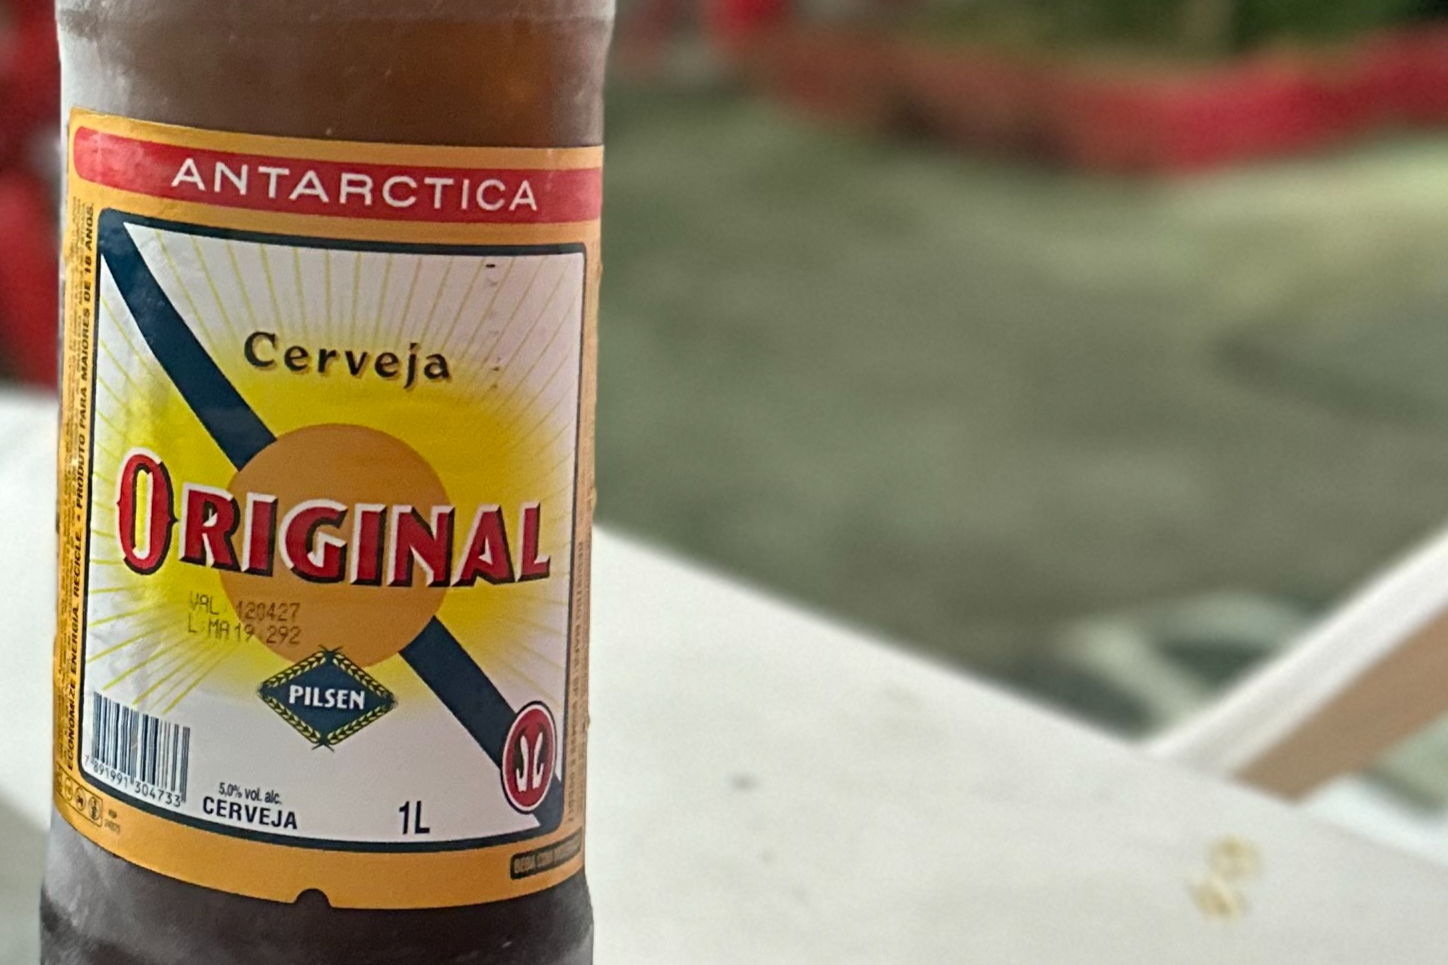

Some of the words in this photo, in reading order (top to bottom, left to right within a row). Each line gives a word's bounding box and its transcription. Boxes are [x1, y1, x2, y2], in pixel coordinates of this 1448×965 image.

[171, 158, 538, 211] ANTARCTICA
[84, 257, 92, 274] 18
[83, 281, 92, 302] DE
[81, 310, 91, 381] MAIORES
[244, 331, 451, 391] Cerveja
[79, 387, 88, 429] PARA
[76, 434, 85, 509] PRODUTO
[116, 447, 551, 587] ORIGINAL
[288, 685, 365, 710] PILSEN
[135, 781, 181, 808] 304733
[203, 796, 297, 829] CERVEJA
[398, 801, 431, 834] 1L
